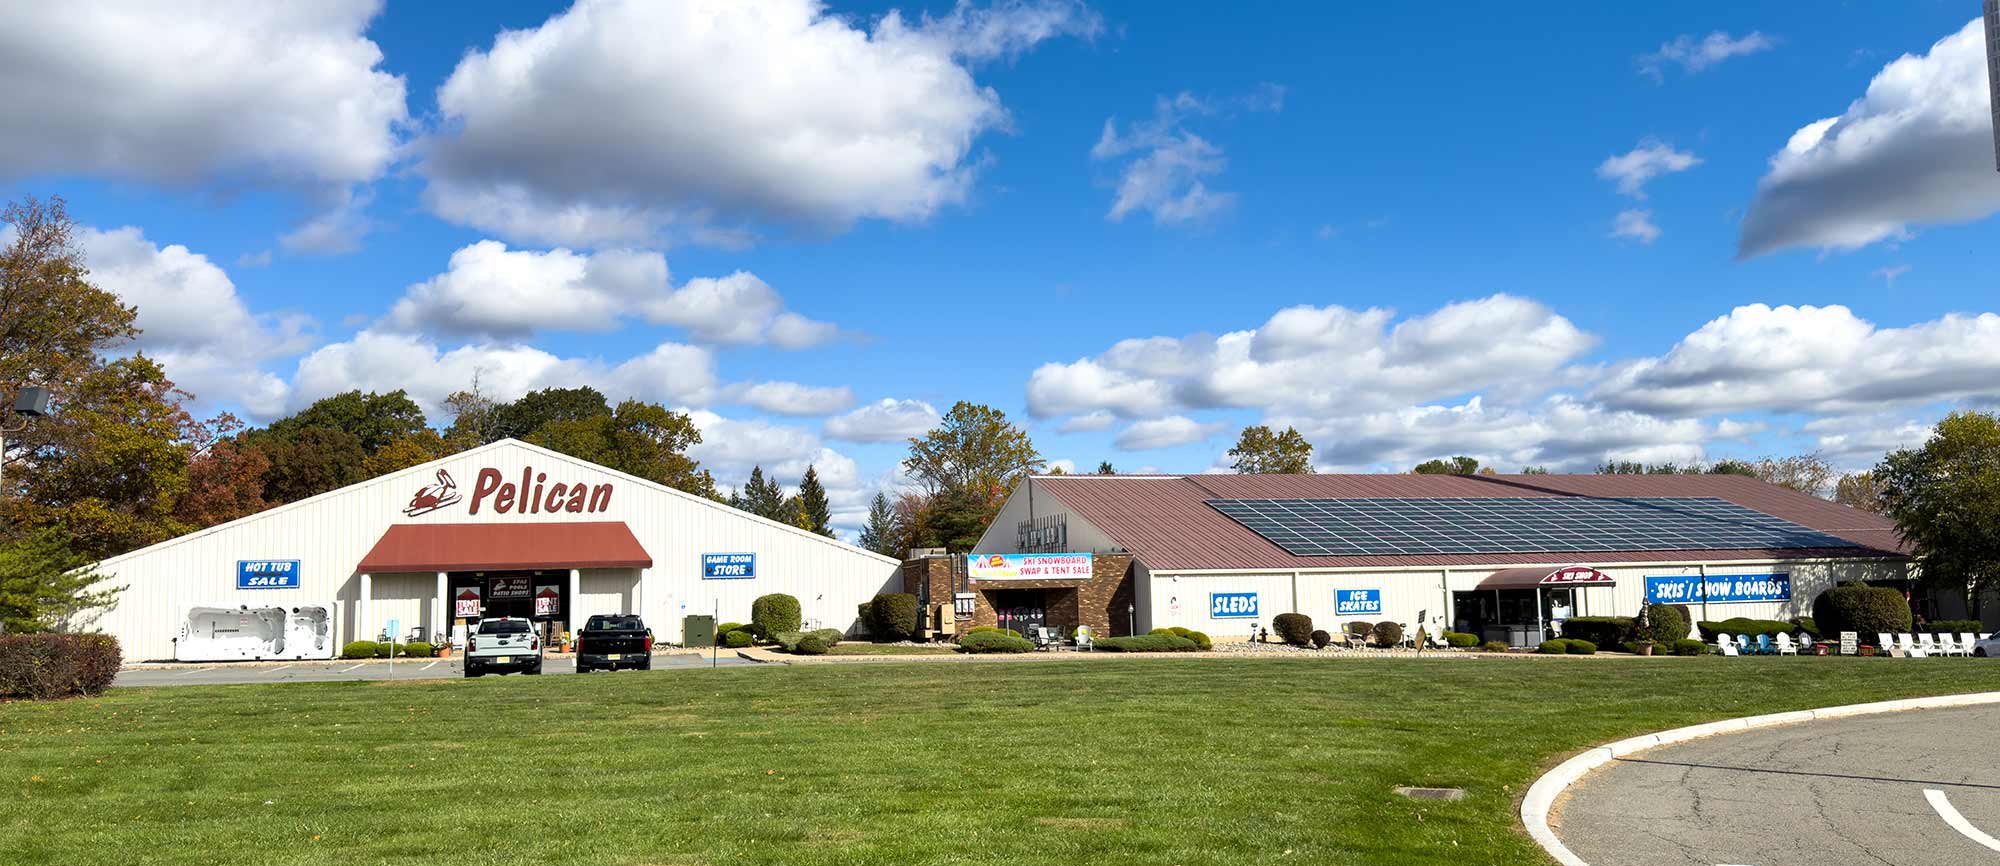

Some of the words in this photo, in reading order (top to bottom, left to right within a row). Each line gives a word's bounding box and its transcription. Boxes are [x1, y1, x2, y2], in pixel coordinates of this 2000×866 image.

[469, 466, 613, 515] Pelican
[706, 556, 729, 564] GAME
[730, 555, 752, 563] ROOM
[1023, 557, 1036, 566] SKI
[1038, 556, 1087, 565] SNOWBOARD
[245, 562, 268, 572] HOT
[270, 562, 292, 572] TUB
[713, 564, 746, 576] STORE
[1020, 567, 1041, 575] SWAP
[1044, 566, 1049, 574] &
[1052, 566, 1070, 574] TENT
[1072, 565, 1090, 574] SALE
[1562, 571, 1575, 580] SKI
[1575, 571, 1594, 580] SHOP
[247, 576, 289, 586] SALE
[1349, 590, 1368, 601] ICE
[1656, 582, 1685, 599] SKIS
[458, 600, 479, 608] TENT
[537, 597, 558, 606] TENT
[1213, 596, 1257, 614] SLEDS
[1339, 600, 1380, 612] SKATES
[458, 606, 479, 615] SALE
[537, 604, 558, 613] SALE
